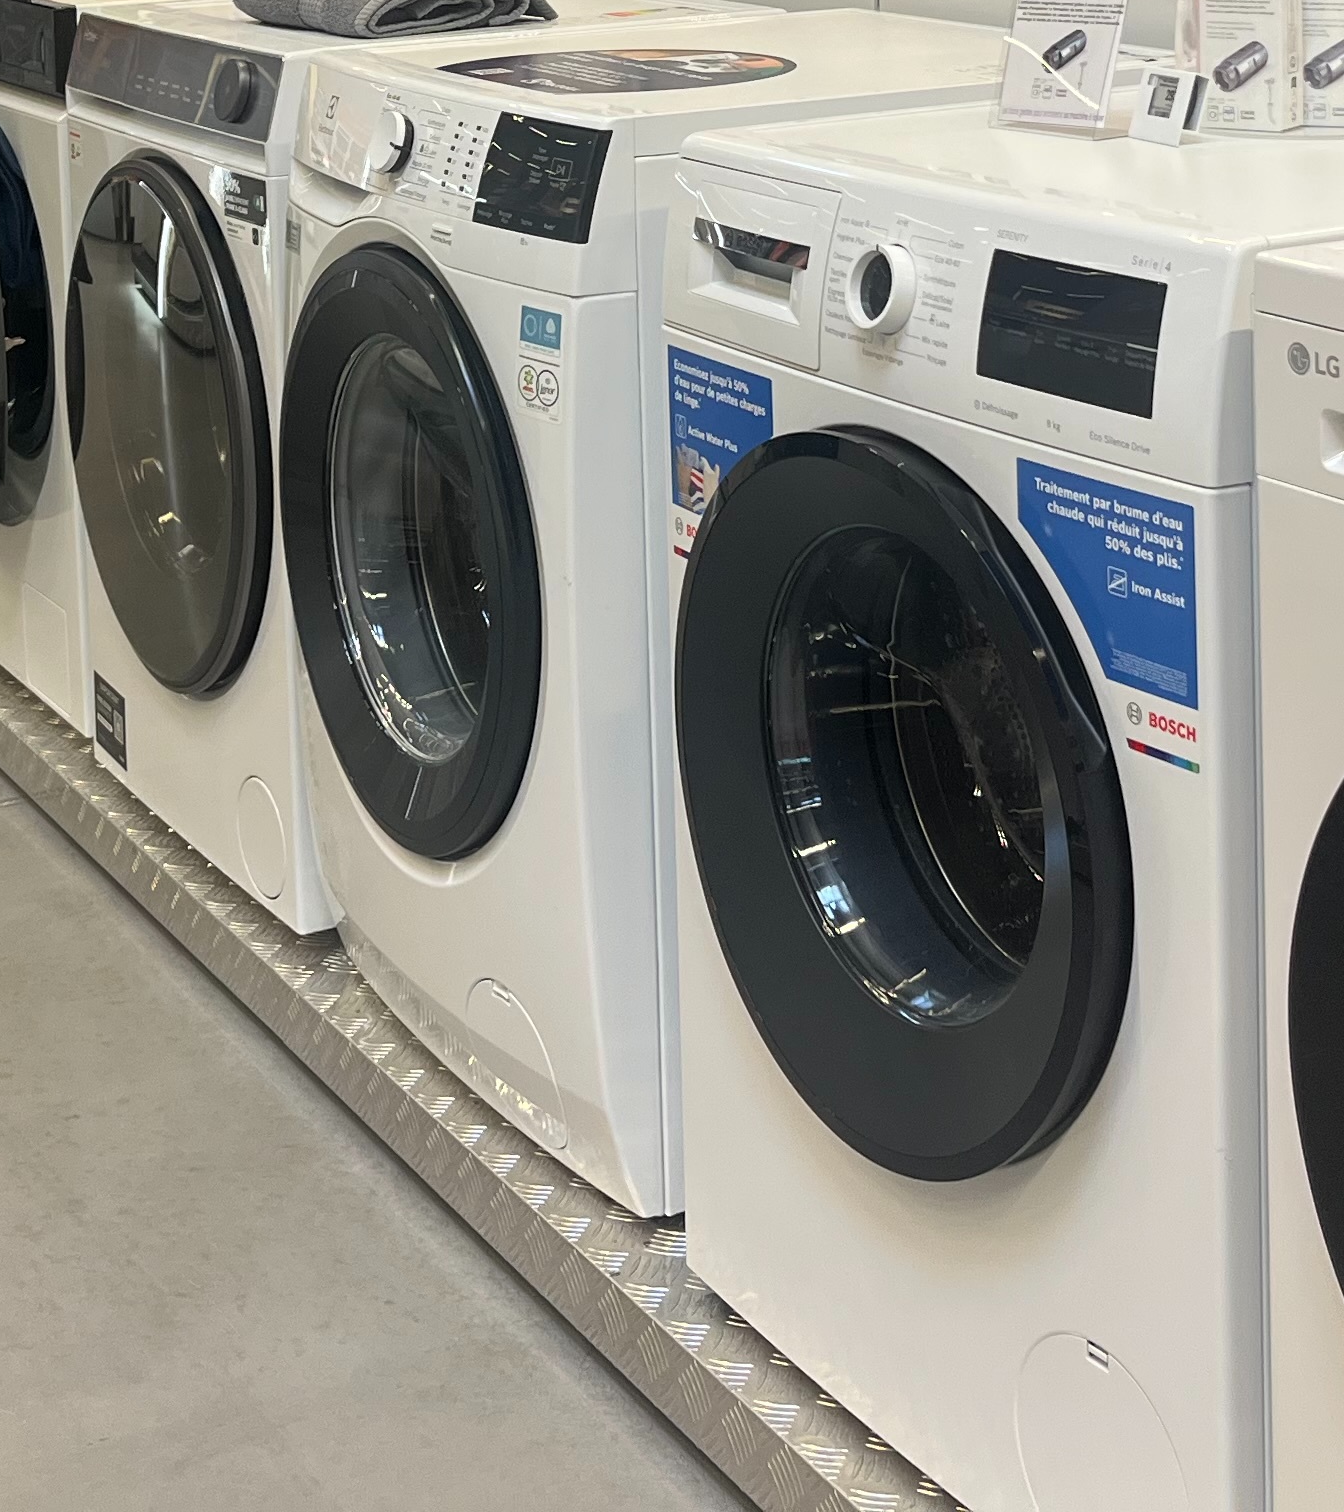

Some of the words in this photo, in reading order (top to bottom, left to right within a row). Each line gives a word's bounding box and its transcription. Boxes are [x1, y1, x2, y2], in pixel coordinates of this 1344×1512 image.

[1314, 350, 1341, 380] LG
[690, 382, 706, 396] pour
[706, 386, 715, 399] de
[739, 397, 766, 418] charges
[733, 379, 750, 395] 50%
[1104, 433, 1130, 450] Silence
[1131, 441, 1151, 456] Drive
[1034, 476, 1091, 507] Traitement
[1093, 495, 1112, 513] par
[1113, 500, 1150, 523] brume
[1152, 511, 1184, 532] d'eau
[1047, 501, 1085, 523] chaude
[1087, 512, 1106, 531] qui
[1107, 516, 1141, 539] réduit
[1142, 529, 1184, 554] jusqu'à
[1105, 535, 1131, 556] 50%
[1133, 544, 1154, 562] des
[1131, 580, 1152, 598] Iron
[1154, 586, 1186, 609] Assist
[1148, 711, 1197, 743] BOSCH
